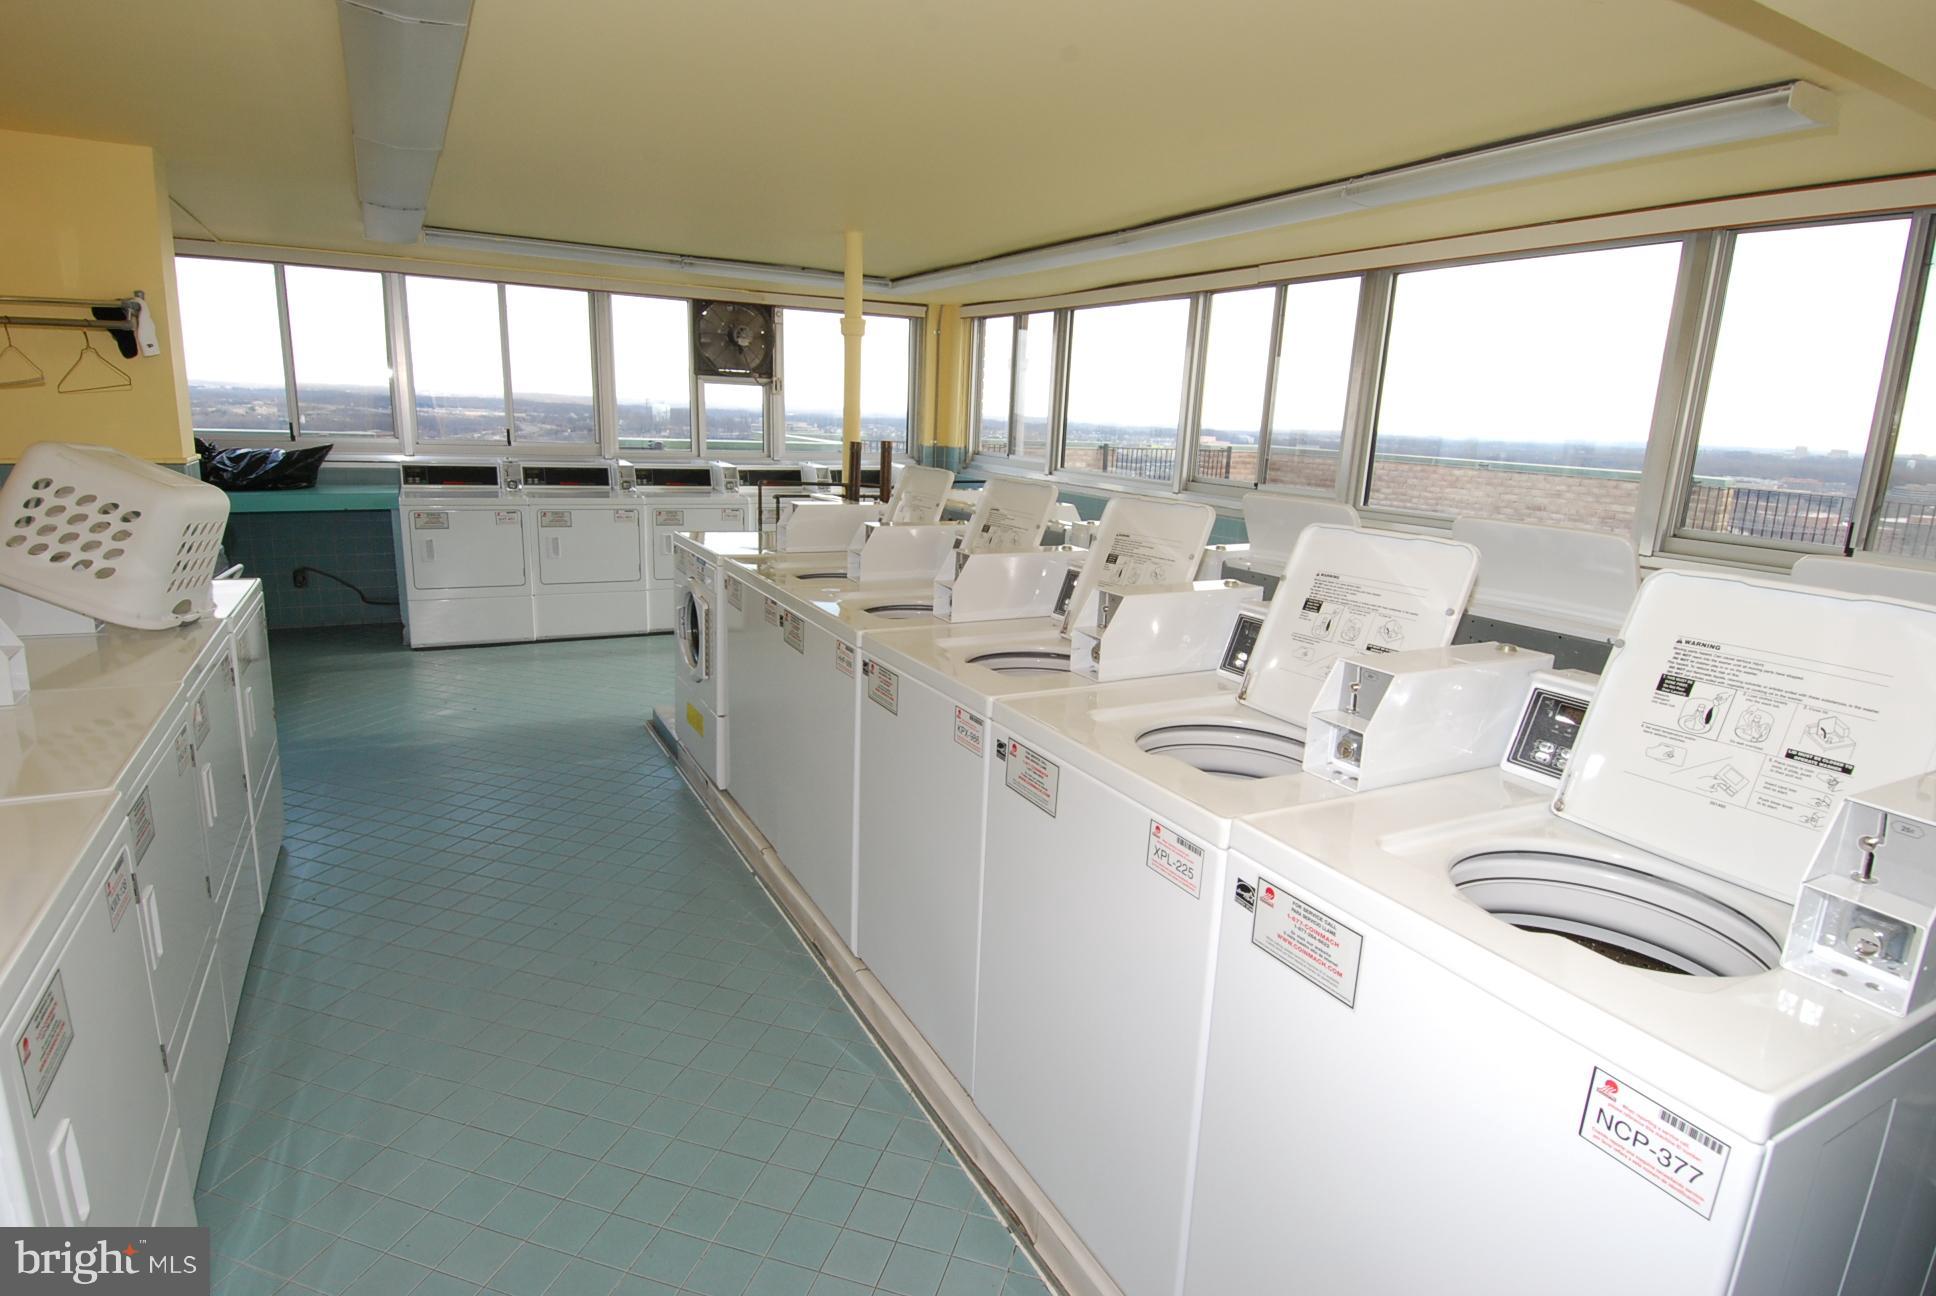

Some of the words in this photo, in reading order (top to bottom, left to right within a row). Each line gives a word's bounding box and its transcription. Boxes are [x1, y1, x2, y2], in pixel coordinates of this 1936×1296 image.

[1684, 639, 1721, 650] WARNING
[1153, 845, 1194, 880] XPL-225
[1292, 900, 1302, 910] FOR
[1302, 907, 1322, 922] SERVICE
[1324, 919, 1336, 930] CALL
[1302, 913, 1321, 928] SERVICIO
[1596, 1107, 1704, 1184] NCP-377
